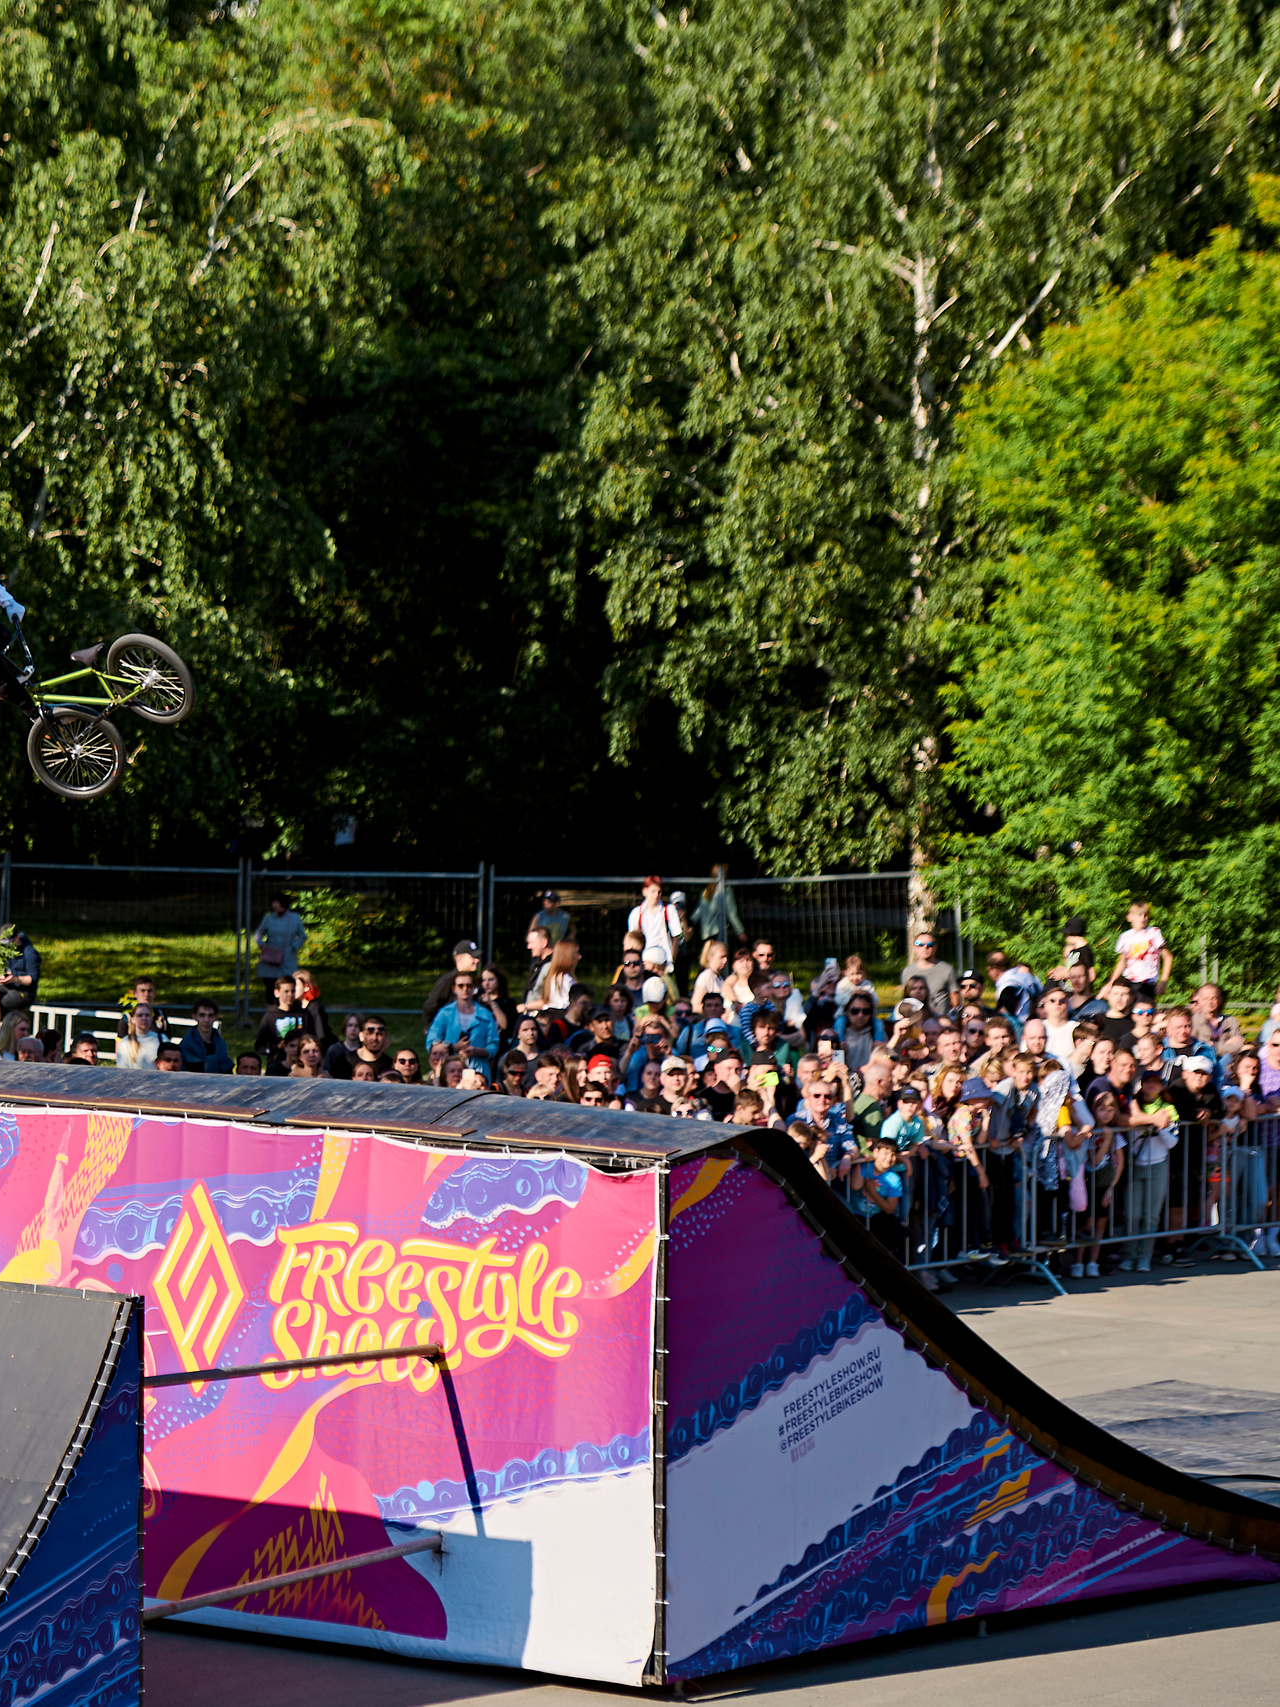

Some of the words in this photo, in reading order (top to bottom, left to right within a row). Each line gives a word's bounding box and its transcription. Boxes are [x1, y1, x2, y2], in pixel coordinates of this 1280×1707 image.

[260, 1299, 462, 1392] Show
[783, 1346, 881, 1418] FREESTYLESHOW.RU
[778, 1361, 882, 1437] #FREESTYLEBIKESHOW
[779, 1376, 884, 1454] @FREESTYLEBIKESHOW
